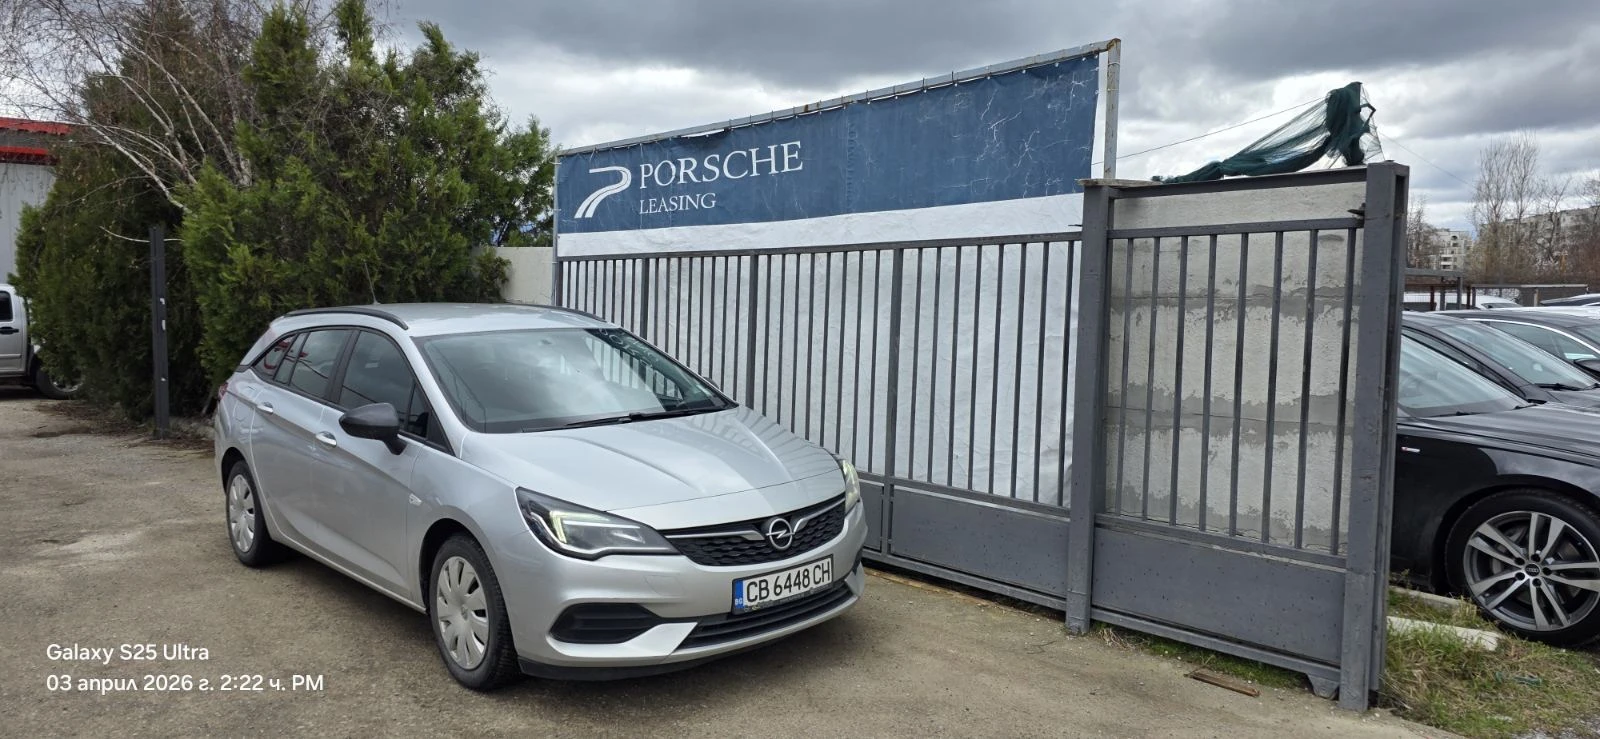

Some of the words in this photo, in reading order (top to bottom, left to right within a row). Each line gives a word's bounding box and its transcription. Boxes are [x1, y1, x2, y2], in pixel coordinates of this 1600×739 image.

[639, 140, 803, 189] PORSCHE
[639, 192, 716, 214] LEASING
[747, 579, 770, 602] CB
[773, 568, 810, 596] 6448
[813, 561, 830, 585] CH
[734, 597, 743, 605] BG
